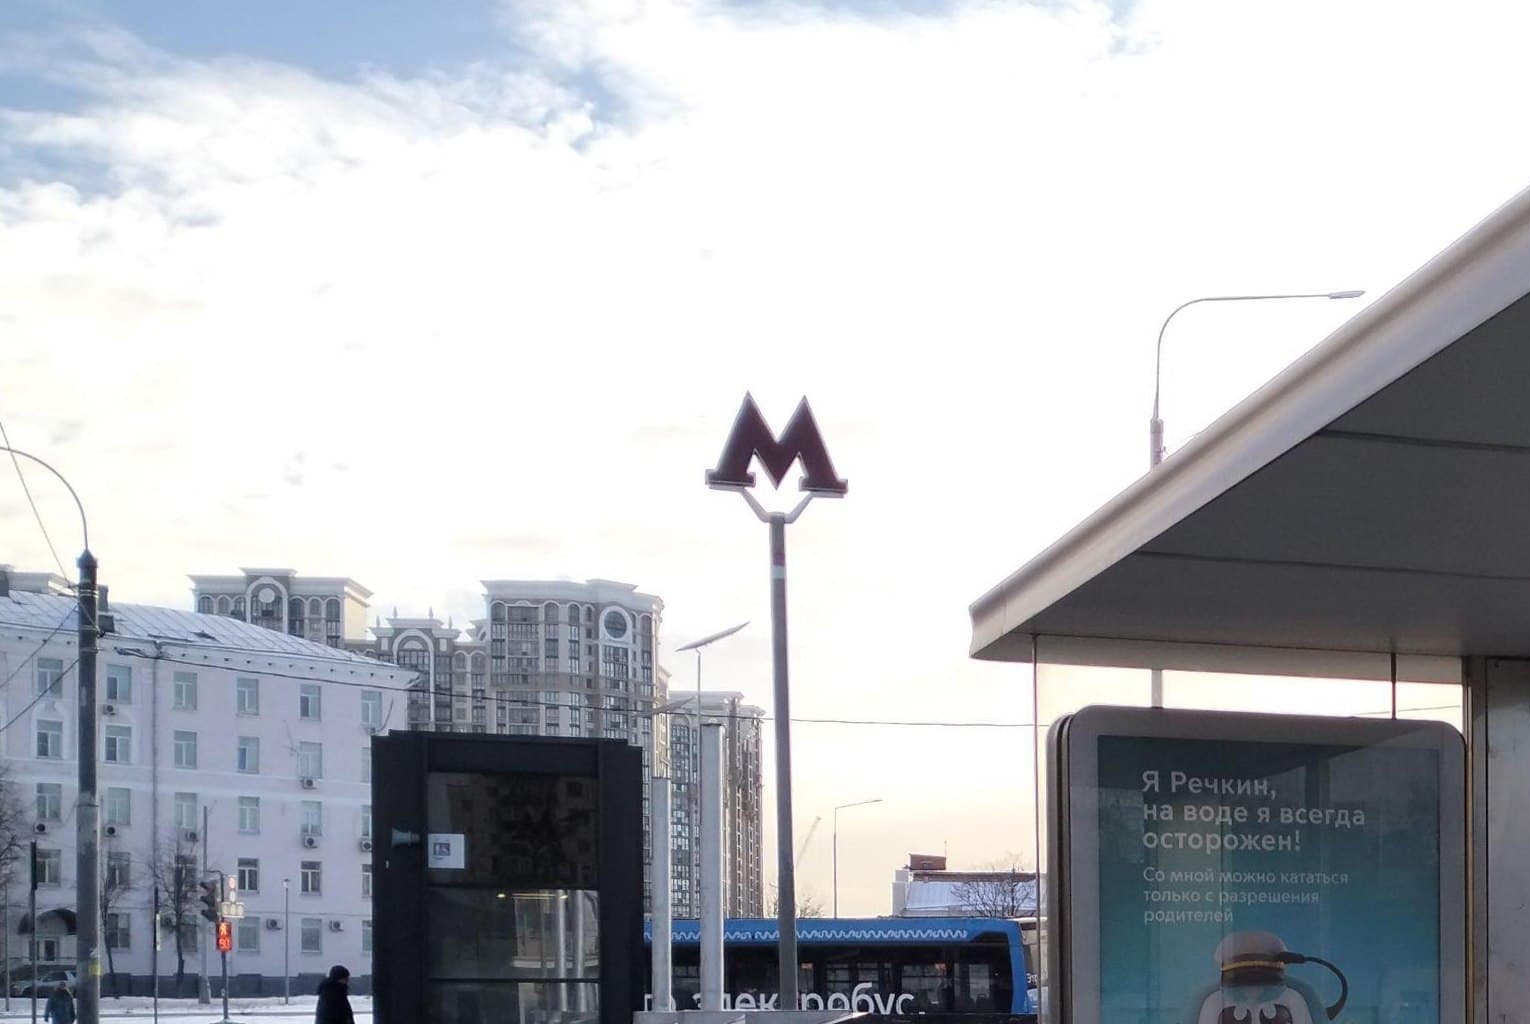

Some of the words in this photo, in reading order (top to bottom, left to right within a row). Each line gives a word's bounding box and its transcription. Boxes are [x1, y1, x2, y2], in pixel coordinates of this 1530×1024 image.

[1142, 770, 1160, 793] Я
[1171, 771, 1277, 800] Речкин,
[1144, 803, 1174, 821] на
[1184, 804, 1249, 826] воде
[1257, 807, 1271, 823] я
[1280, 808, 1366, 829] всегда
[1143, 829, 1301, 854] осторожен!
[1143, 867, 1166, 882] Со
[1170, 868, 1214, 883] мной
[1220, 870, 1276, 883] можно
[1281, 871, 1349, 884] кататься
[1144, 890, 1201, 903] только
[1205, 891, 1215, 903] с
[1219, 892, 1320, 906] разрешения
[1144, 908, 1234, 924] родителей
